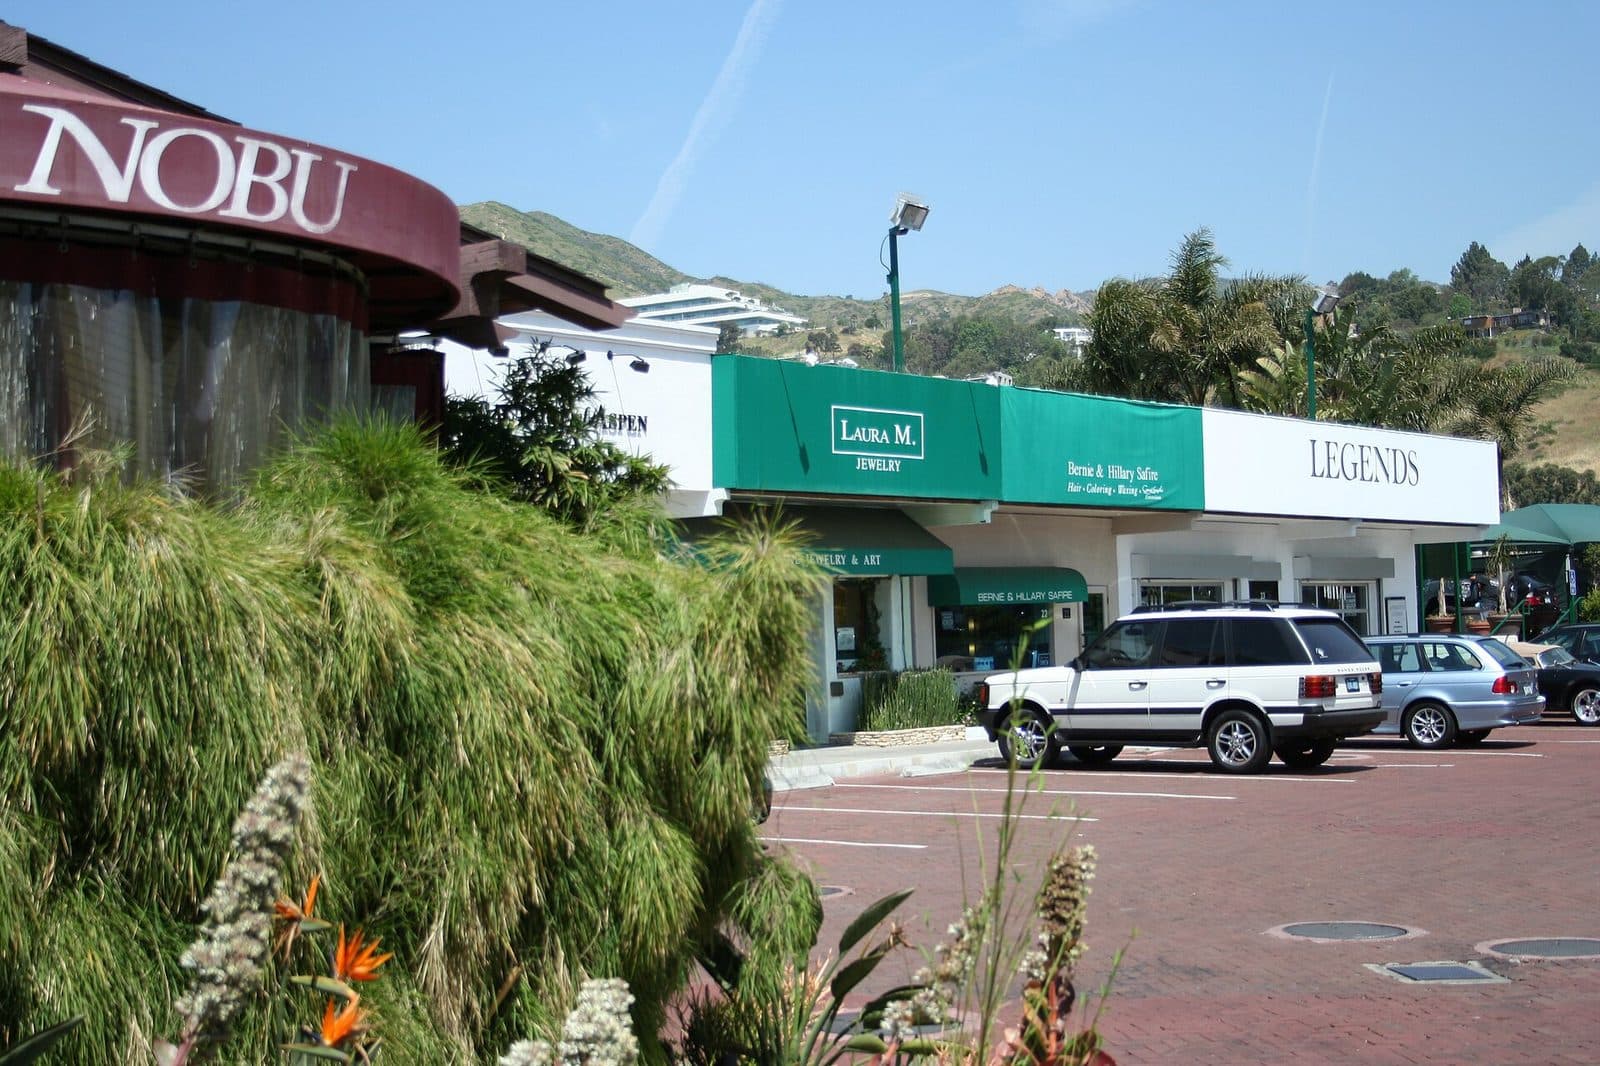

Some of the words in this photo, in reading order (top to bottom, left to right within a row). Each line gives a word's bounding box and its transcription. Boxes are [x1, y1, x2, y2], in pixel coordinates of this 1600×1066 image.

[14, 104, 358, 234] NOBU
[894, 424, 916, 445] M.
[856, 457, 901, 472] JEWELRY
[1309, 439, 1419, 486] LEGENDS
[1068, 461, 1094, 478] Bernie
[1096, 464, 1104, 478] &
[1108, 465, 1134, 483] Hillary
[1136, 467, 1159, 481] Safire
[1067, 482, 1082, 493] Hair
[851, 554, 859, 565] &
[863, 554, 881, 566] ART
[1016, 591, 1046, 601] HILLARY
